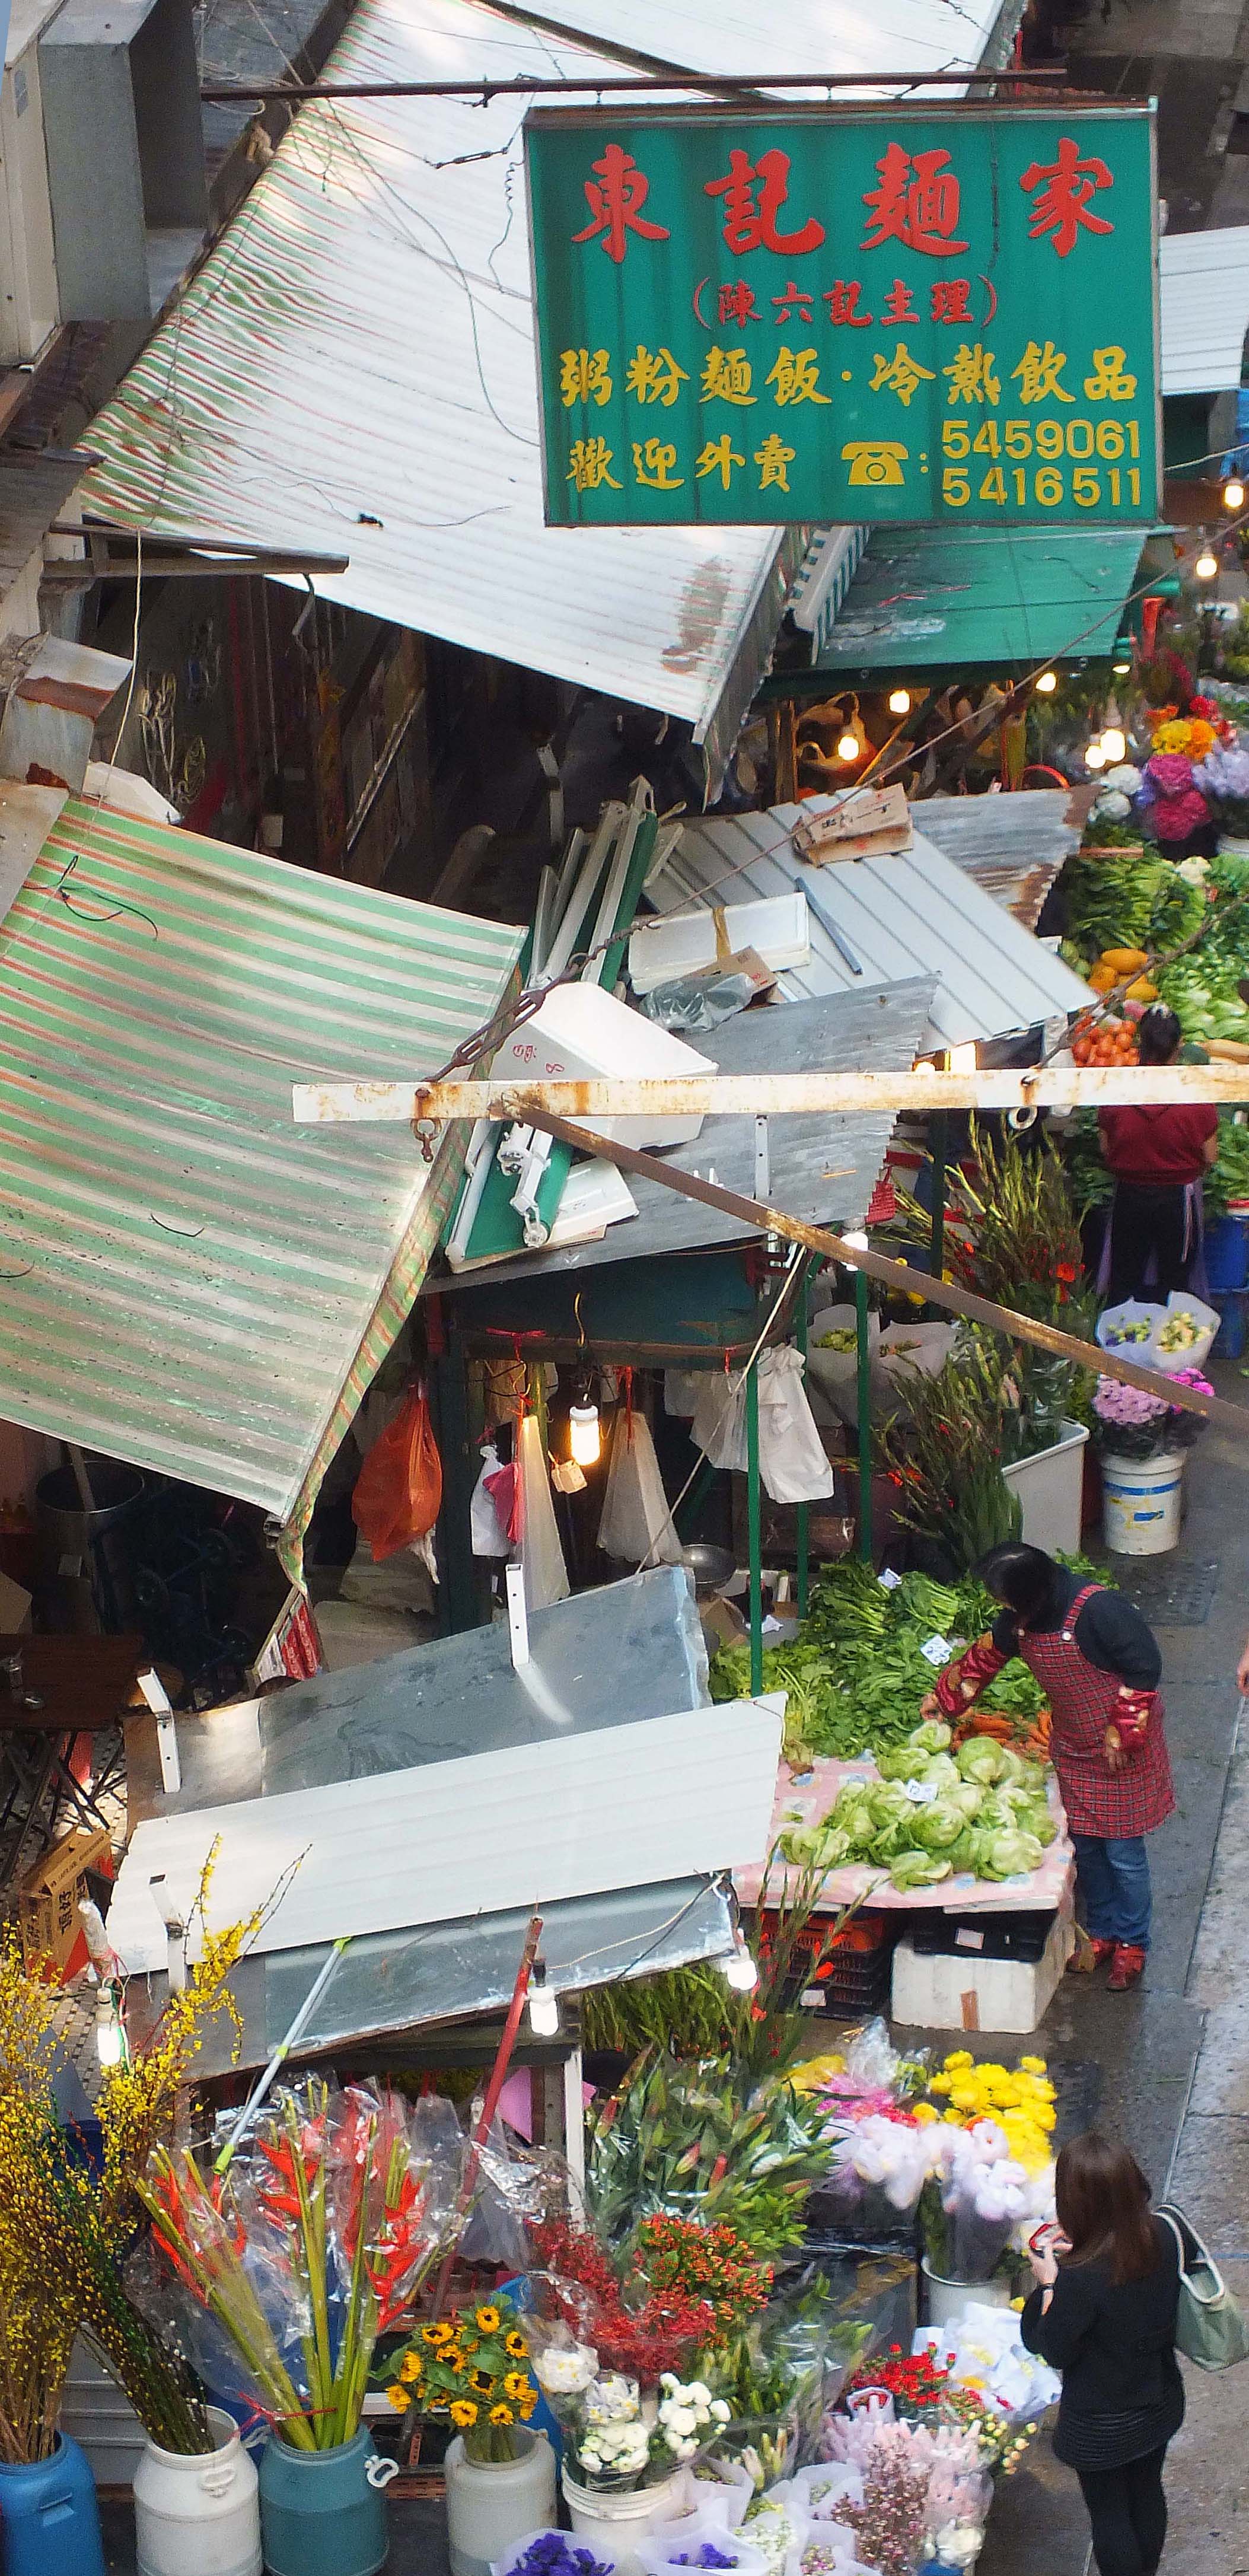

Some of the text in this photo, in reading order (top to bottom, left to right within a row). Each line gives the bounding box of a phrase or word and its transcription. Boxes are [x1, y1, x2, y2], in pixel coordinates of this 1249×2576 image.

[571, 137, 1115, 263] 東記麵家
[565, 434, 796, 492] 歡迎外賣
[942, 419, 1139, 460] 5459061
[942, 467, 1140, 507] 5416511
